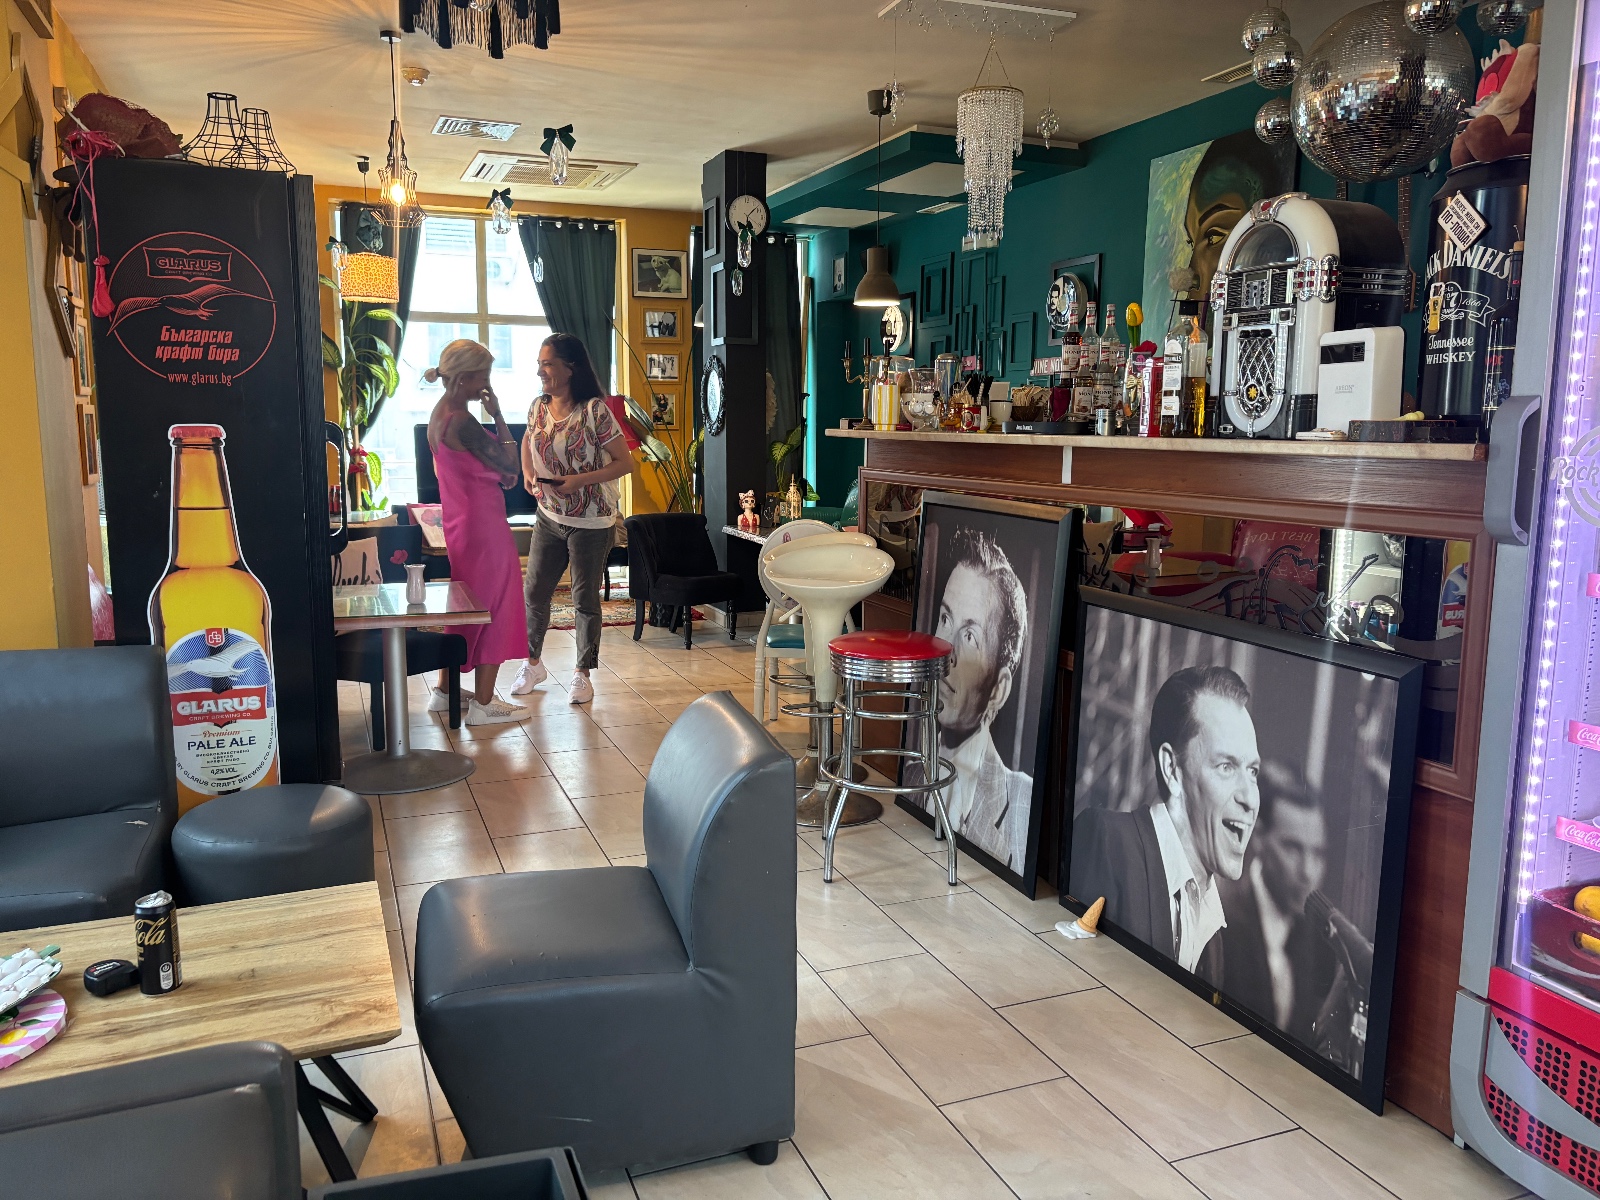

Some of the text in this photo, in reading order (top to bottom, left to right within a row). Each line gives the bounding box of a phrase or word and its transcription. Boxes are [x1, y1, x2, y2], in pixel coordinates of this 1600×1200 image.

[1464, 209, 1475, 224] ЖЕНА
[155, 256, 222, 272] GLARUS
[1424, 249, 1442, 288] ACK
[160, 325, 233, 345] Българска
[1428, 335, 1474, 349] Tennessee
[155, 344, 240, 364] крафт бира
[1426, 351, 1476, 364] WHISKEY
[167, 371, 232, 386] www.glarus.bg
[176, 695, 262, 716] GLARUS
[202, 728, 241, 738] Premium
[187, 735, 257, 751] PALE ALE
[183, 770, 209, 787] GLARUS
[210, 780, 236, 788] CRAFT
[238, 762, 266, 784] BREWING
